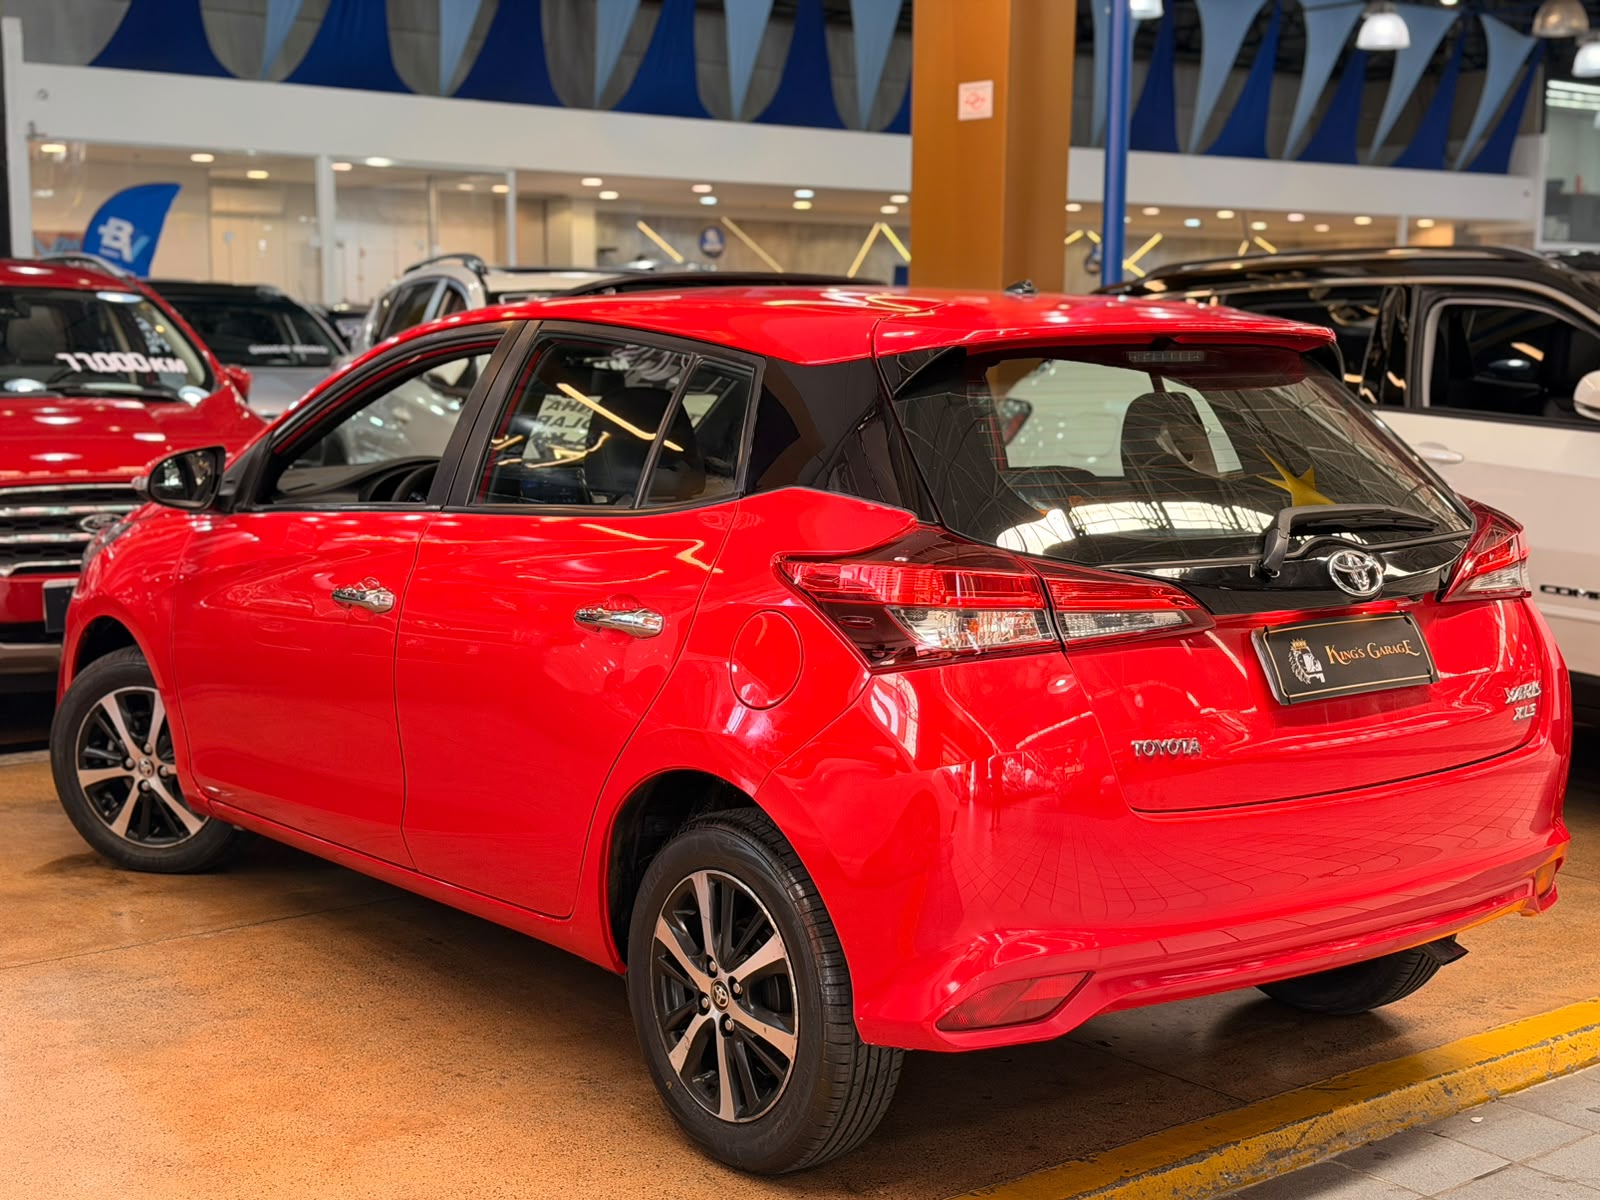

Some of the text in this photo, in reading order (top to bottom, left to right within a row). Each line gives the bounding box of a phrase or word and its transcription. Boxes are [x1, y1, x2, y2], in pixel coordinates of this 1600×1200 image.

[1367, 639, 1420, 659] GARAGE
[1503, 680, 1542, 704] YARIS
[1131, 737, 1202, 757] TOYOTA
